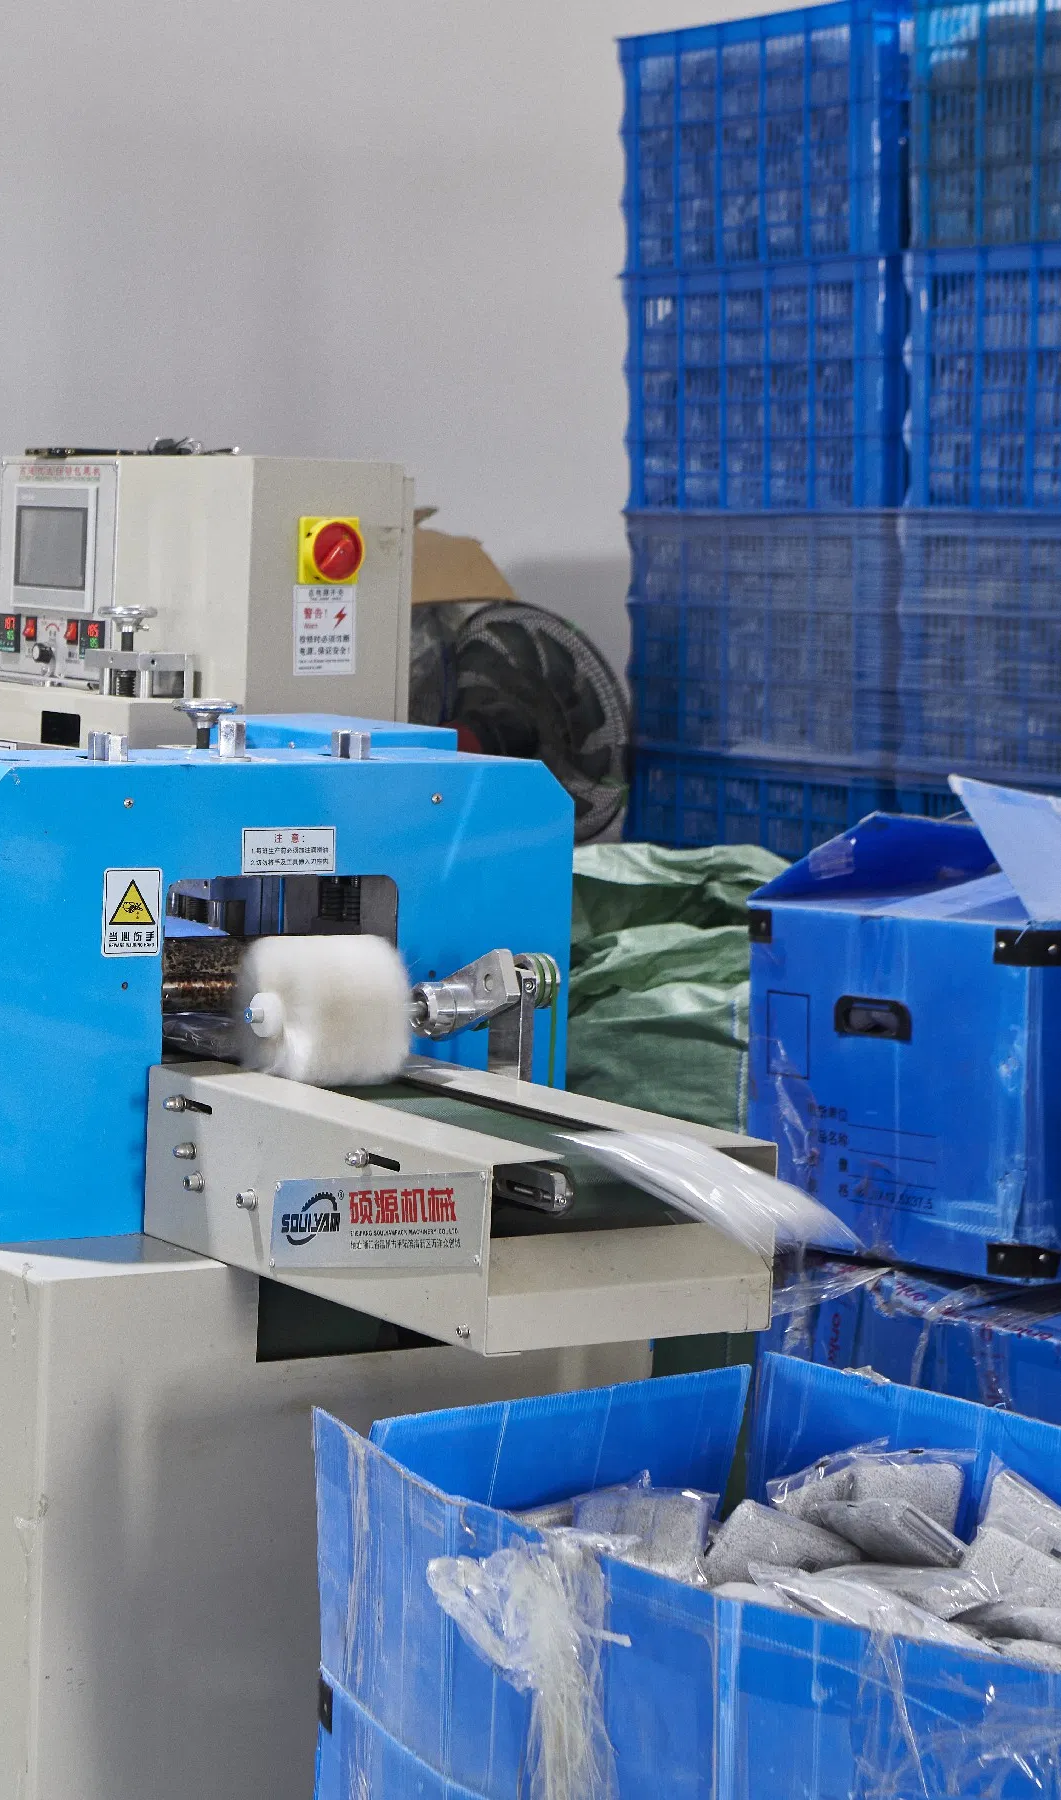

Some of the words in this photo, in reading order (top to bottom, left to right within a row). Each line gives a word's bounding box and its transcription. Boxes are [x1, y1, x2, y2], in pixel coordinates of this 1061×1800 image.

[109, 931, 155, 942] 当心伤手
[348, 1187, 457, 1224] 硕源机械
